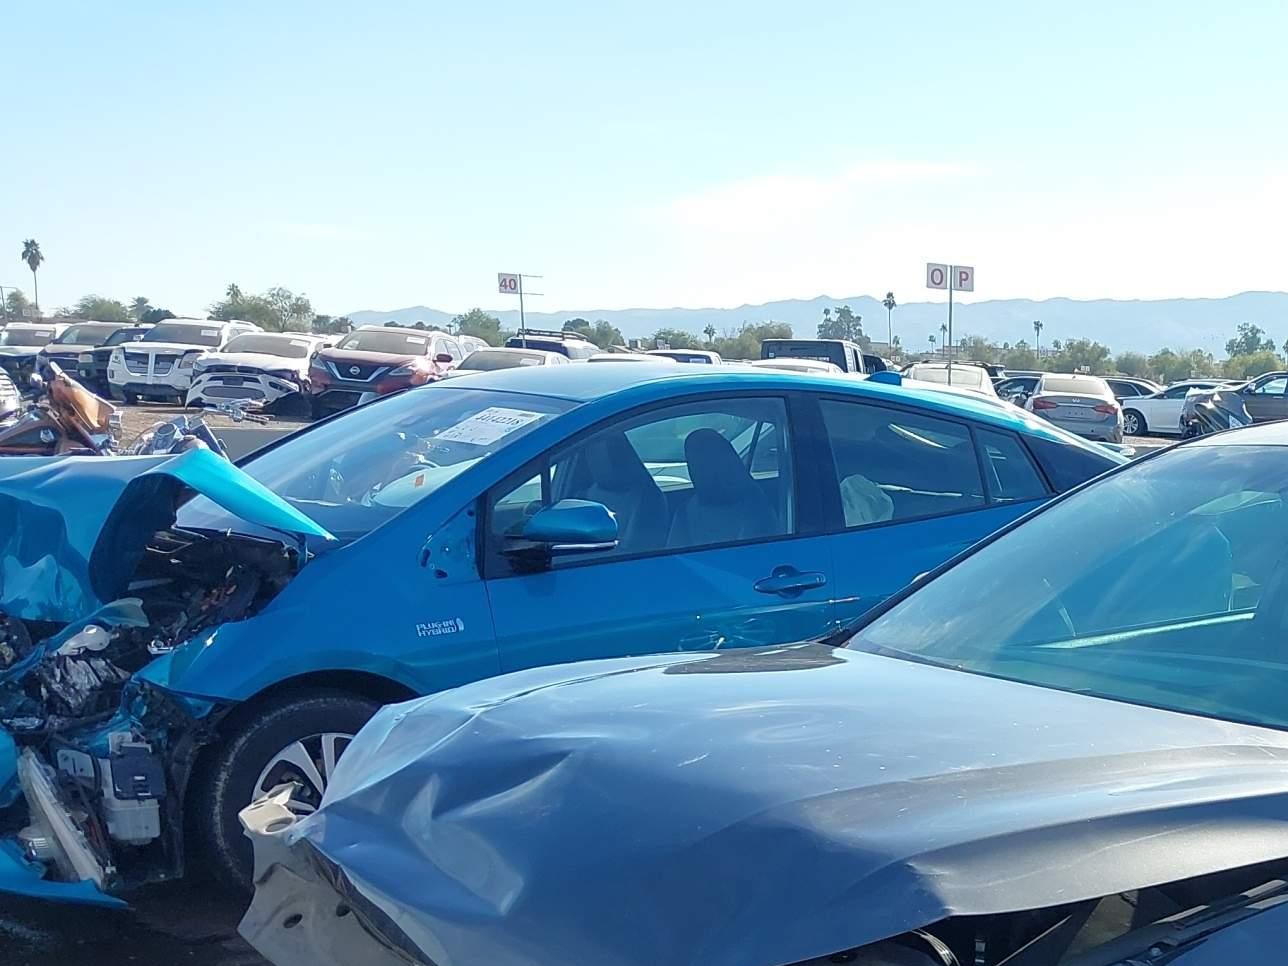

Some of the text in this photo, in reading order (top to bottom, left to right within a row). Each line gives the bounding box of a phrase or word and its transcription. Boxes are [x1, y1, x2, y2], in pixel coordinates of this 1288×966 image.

[500, 278, 516, 290] 40
[959, 270, 969, 287] P
[417, 626, 456, 636] HYBRID
